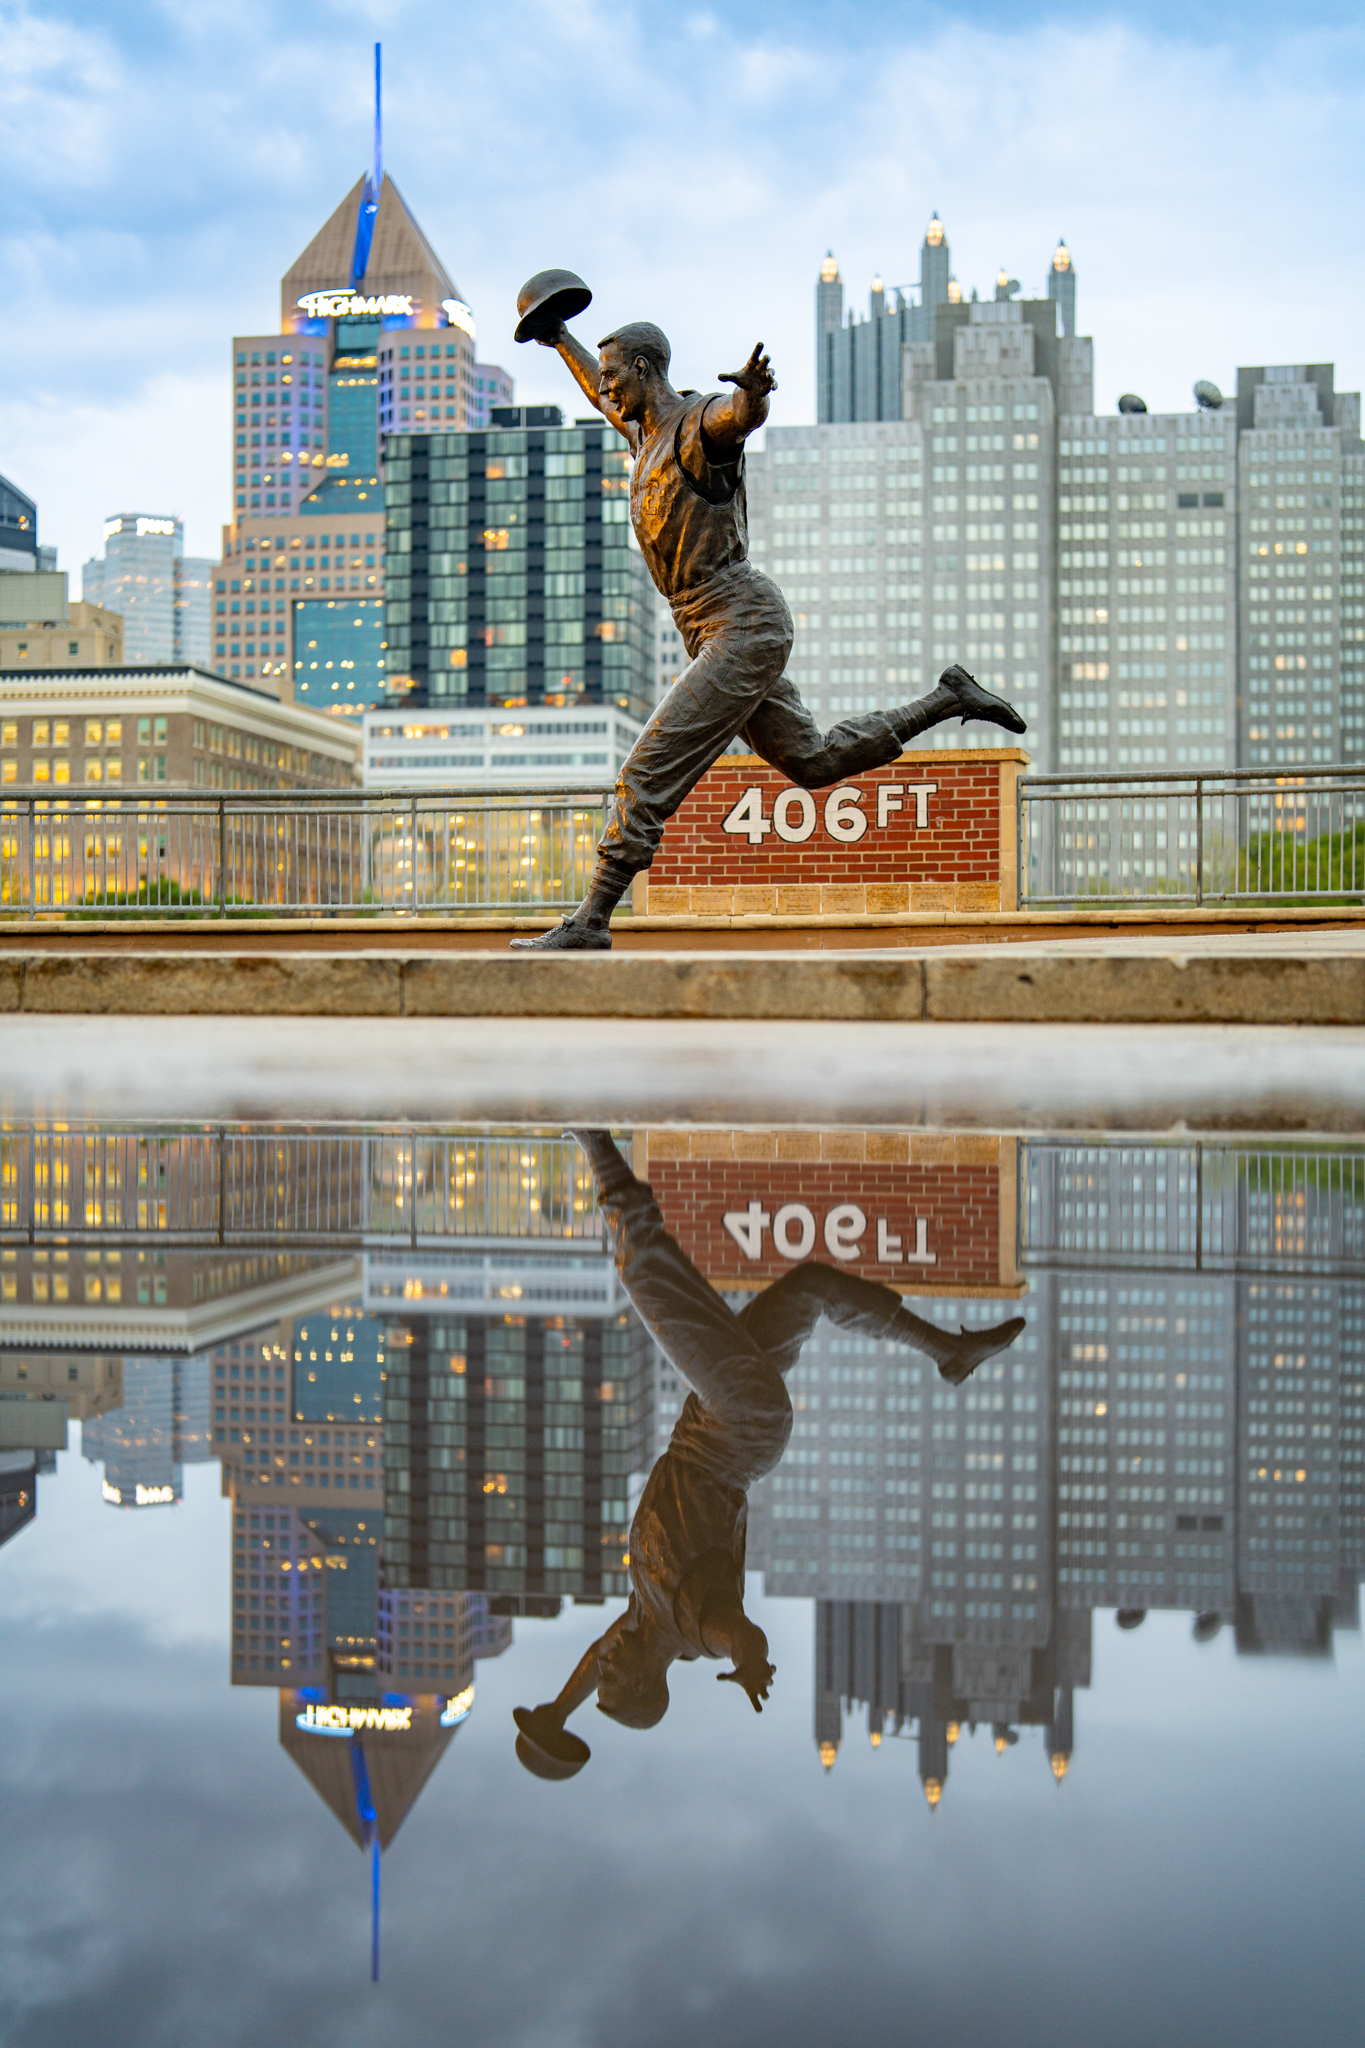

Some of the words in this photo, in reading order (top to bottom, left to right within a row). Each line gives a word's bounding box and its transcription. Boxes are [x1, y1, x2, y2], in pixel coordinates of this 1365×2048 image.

[298, 290, 414, 318] HIGHMARK
[721, 785, 868, 844] 406
[876, 783, 938, 829] FT
